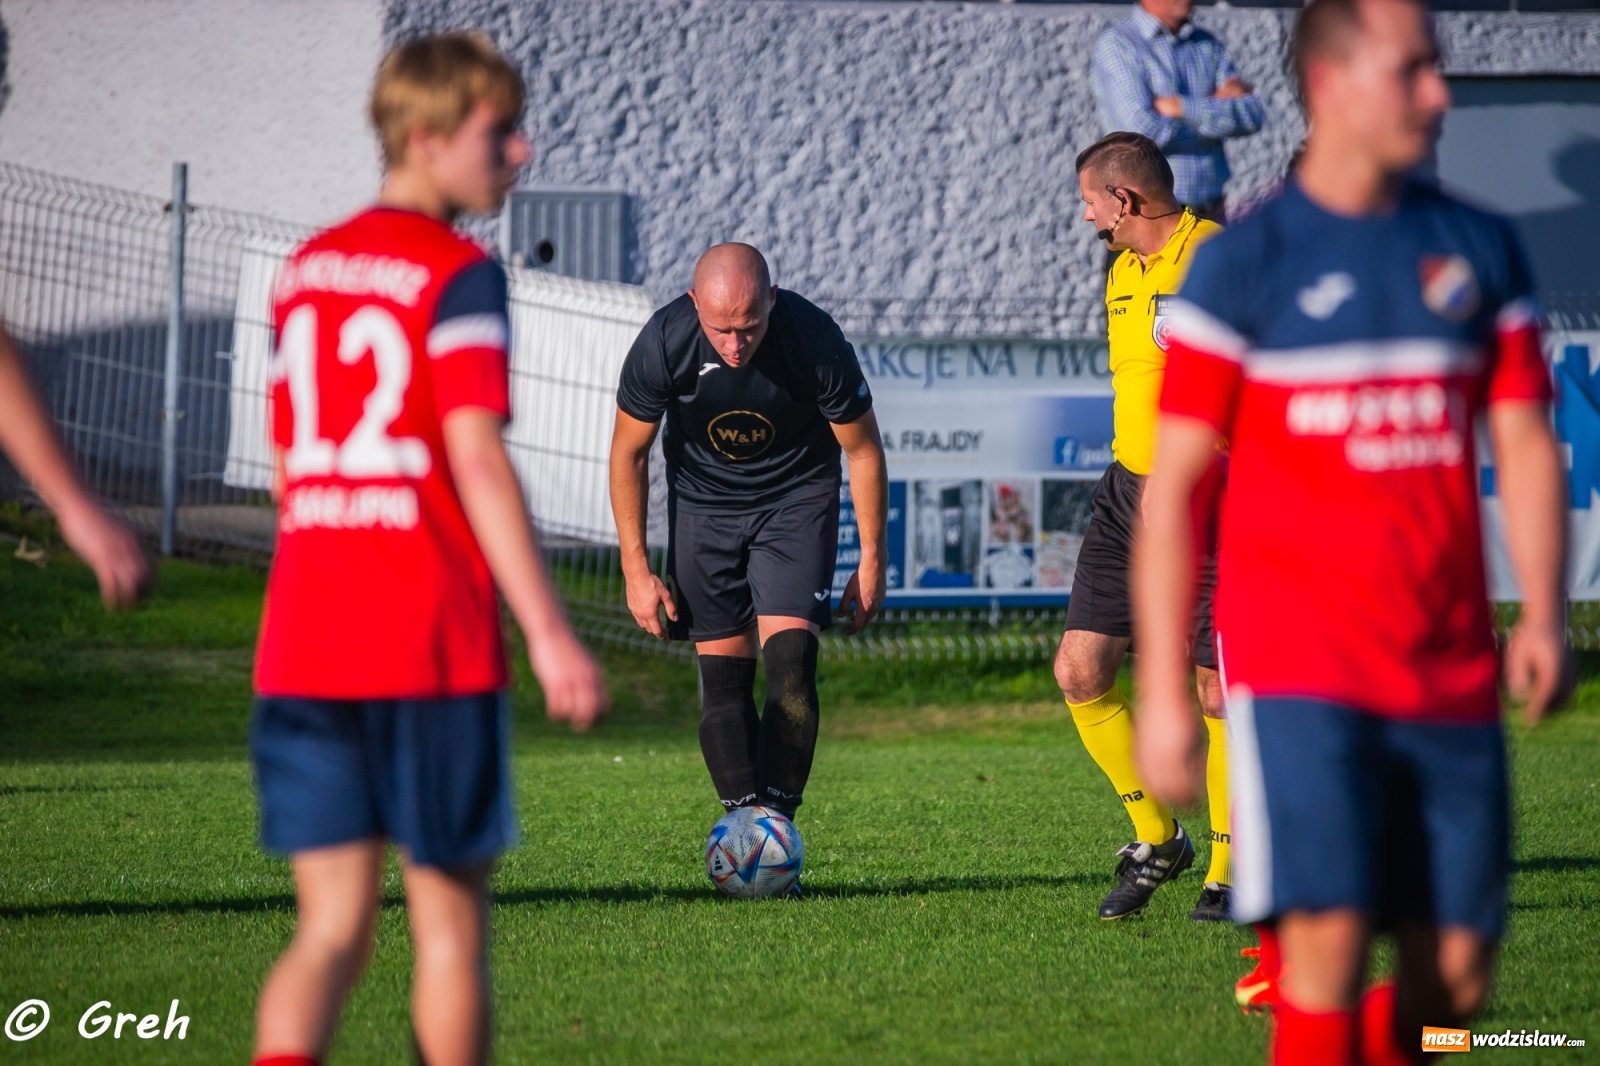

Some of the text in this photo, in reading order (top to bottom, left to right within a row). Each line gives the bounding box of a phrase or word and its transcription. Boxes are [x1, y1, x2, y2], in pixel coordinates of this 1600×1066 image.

[965, 341, 1016, 378] NA
[268, 302, 432, 480] 12
[716, 427, 766, 443] W&H
[900, 429, 985, 452] FRAJDY
